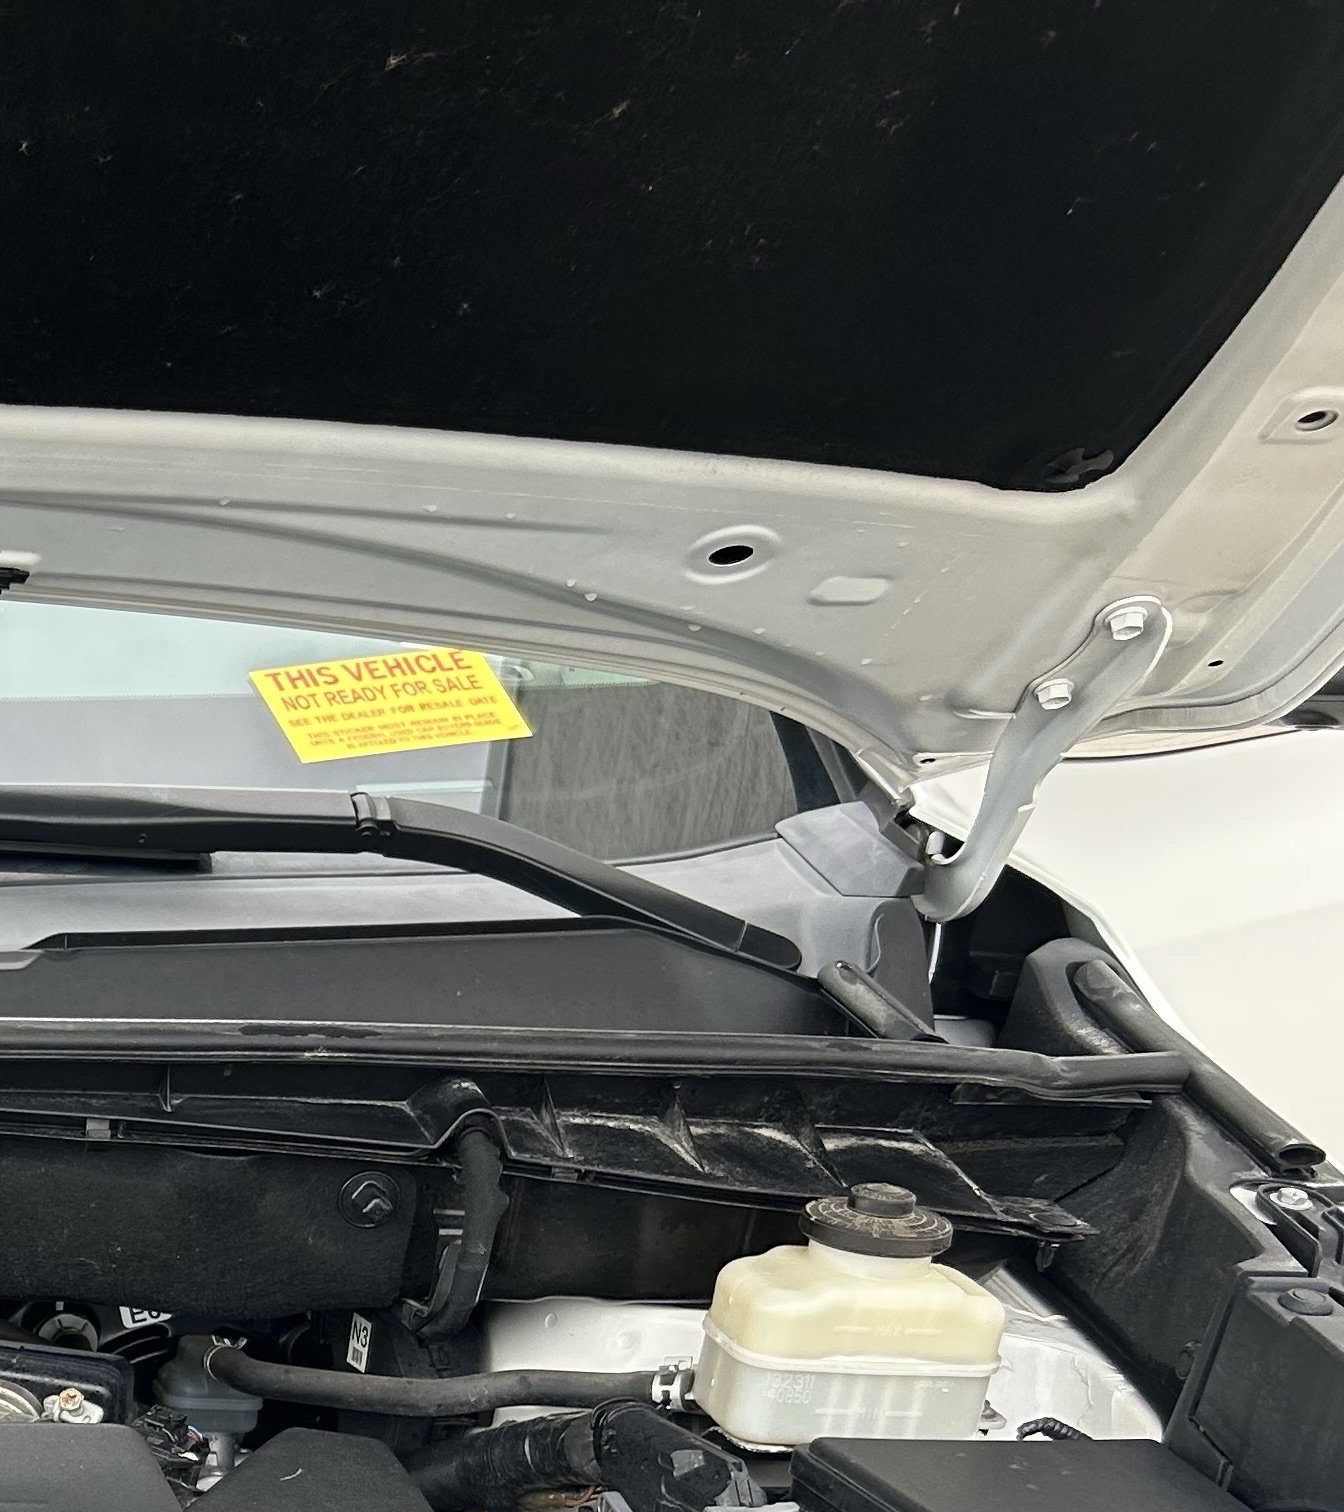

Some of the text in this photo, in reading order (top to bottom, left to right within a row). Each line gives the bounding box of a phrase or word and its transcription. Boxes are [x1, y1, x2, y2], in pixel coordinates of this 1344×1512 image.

[264, 649, 472, 691] THIS VEHICLE
[281, 675, 483, 711] NOT READY FOR SALE
[288, 695, 498, 727] SEE THE DEALER FOR RESALE DATE
[352, 1319, 369, 1348] N3
[874, 1325, 902, 1337] MAX
